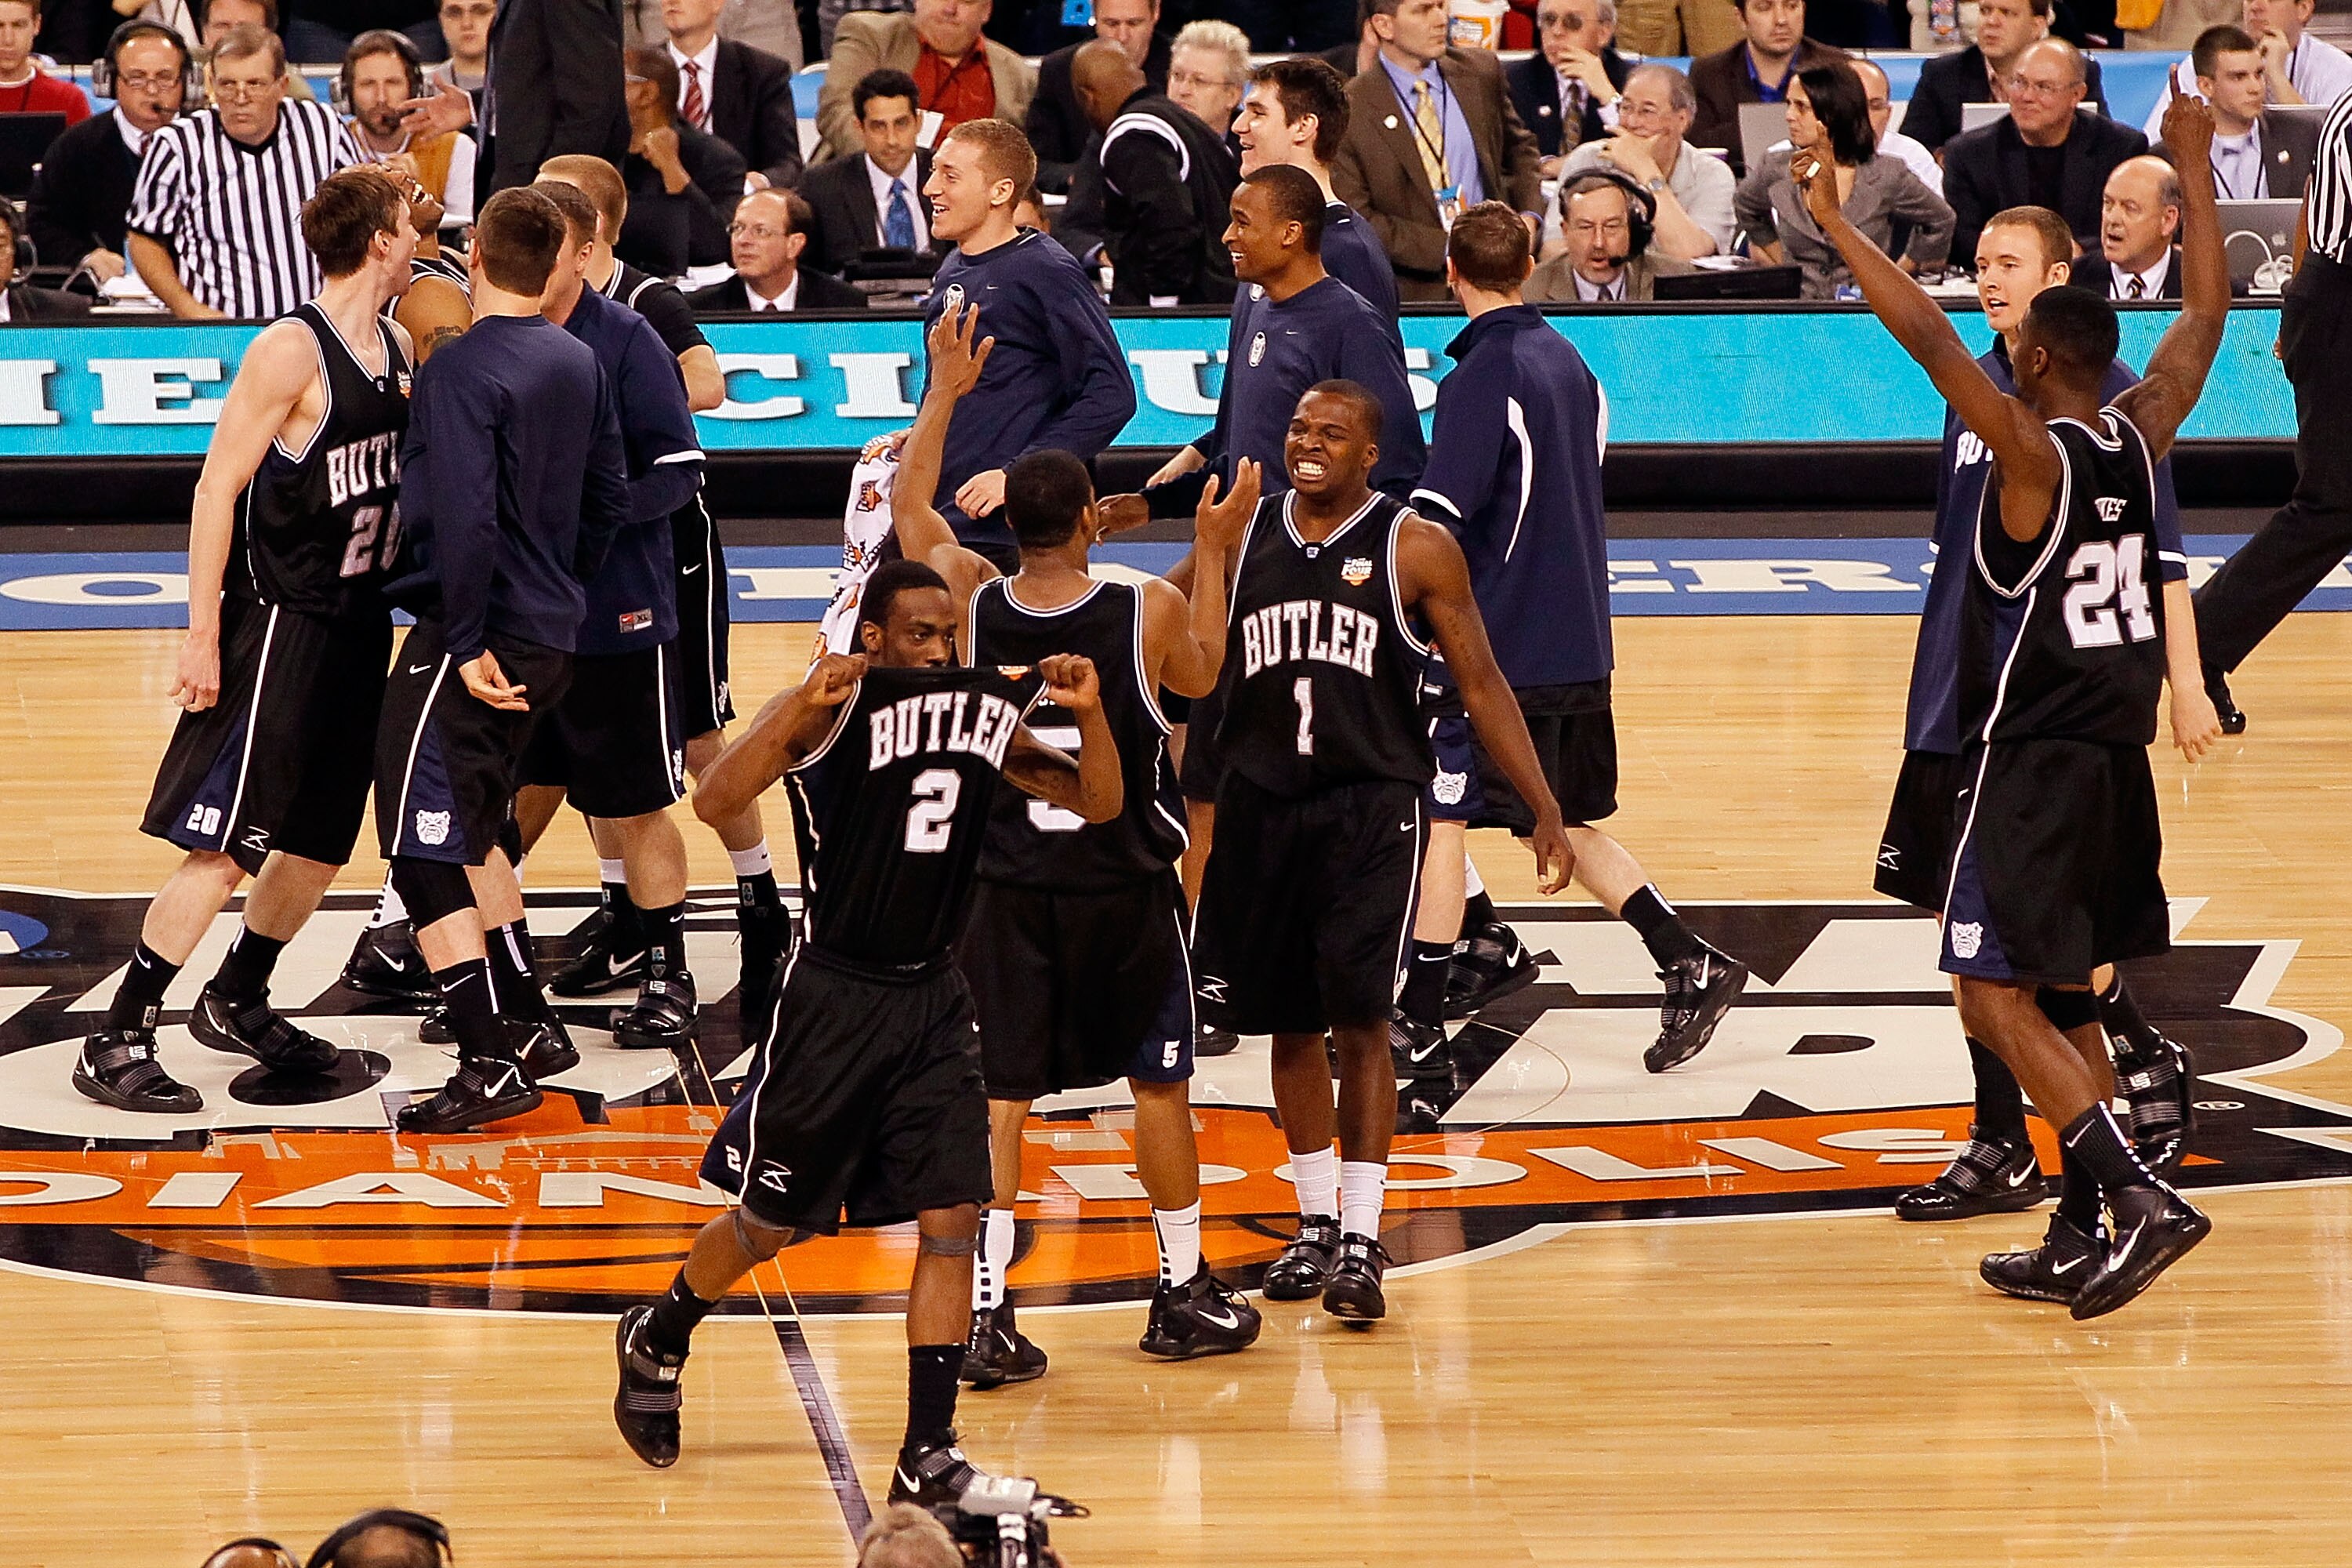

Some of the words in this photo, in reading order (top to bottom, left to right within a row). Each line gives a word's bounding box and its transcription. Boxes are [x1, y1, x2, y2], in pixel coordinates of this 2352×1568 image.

[1955, 430, 1993, 473] BU
[2063, 533, 2157, 648] 24
[1243, 599, 1379, 679] BUTLER
[869, 691, 1020, 771] BUTLER
[1294, 677, 1313, 755] 1
[186, 803, 222, 836] 20
[904, 768, 962, 853] 2
[1162, 1040, 1181, 1069] 5
[724, 1145, 742, 1174] 2
